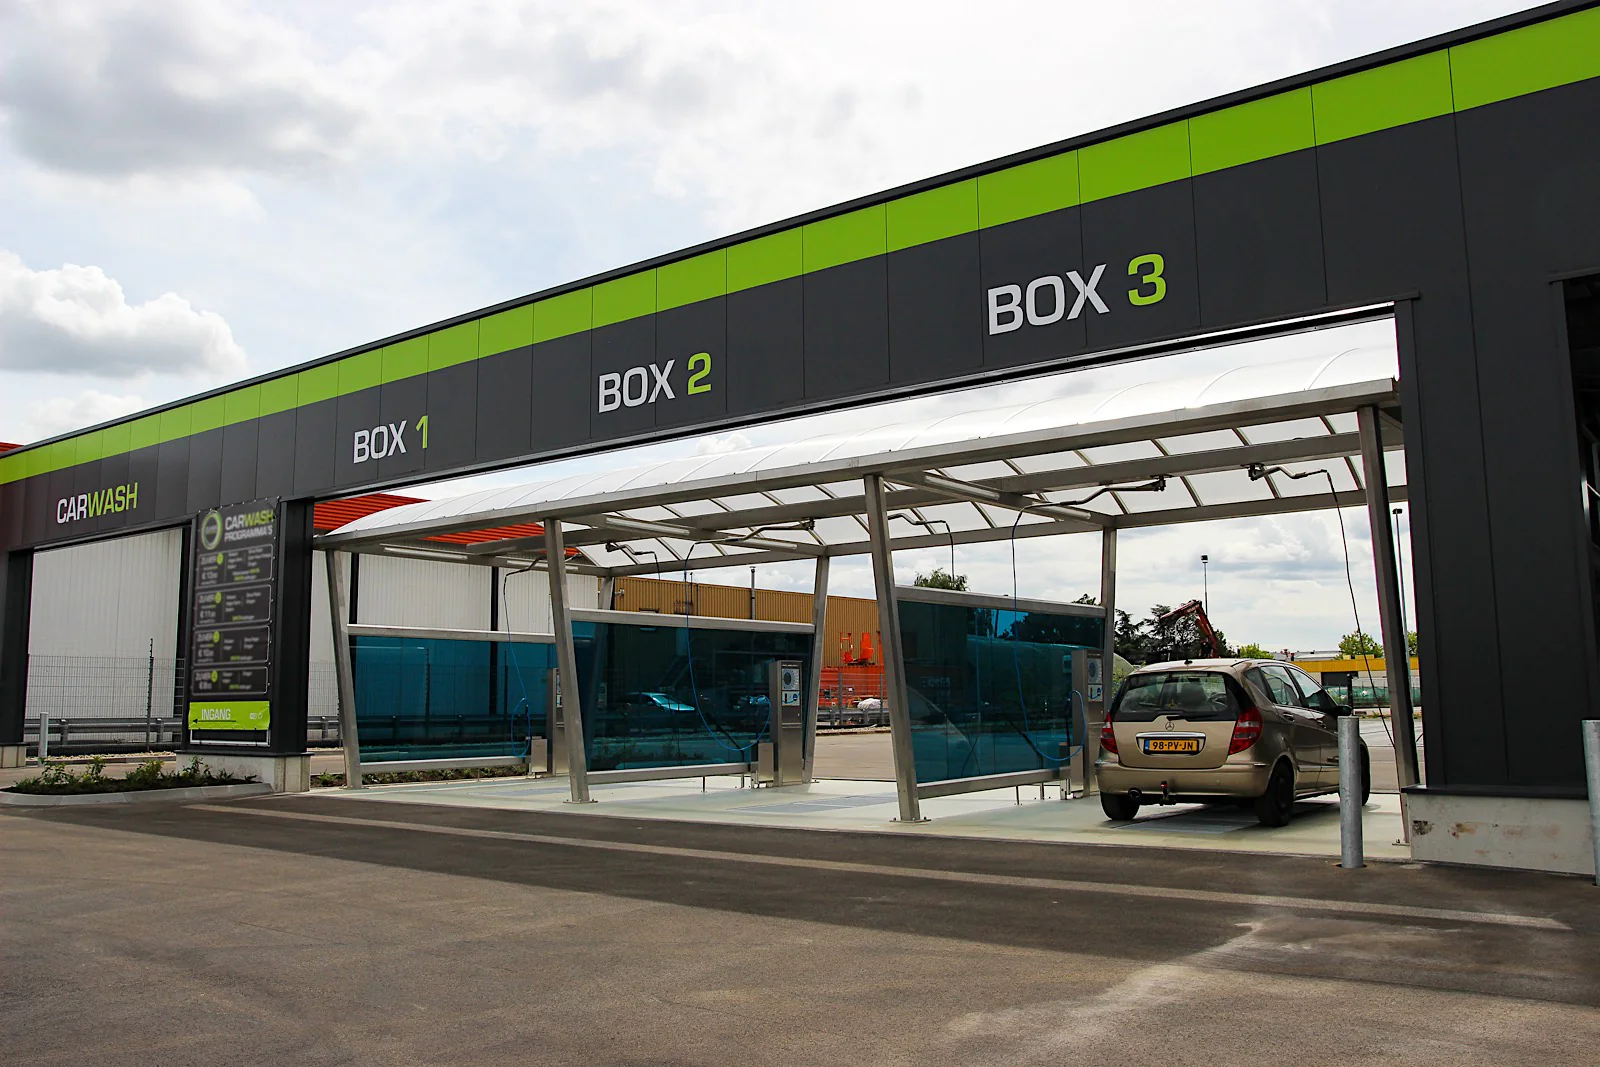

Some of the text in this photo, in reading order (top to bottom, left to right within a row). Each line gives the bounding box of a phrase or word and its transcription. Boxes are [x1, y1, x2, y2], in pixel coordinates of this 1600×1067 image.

[987, 253, 1167, 336] BOX 3
[597, 352, 712, 413] BOX 2
[353, 415, 429, 464] BOX 1
[56, 482, 139, 524] CARWASH
[224, 509, 275, 531] CARWASH
[201, 708, 231, 720] INGANG
[1152, 741, 1194, 750] 98-PV-JN
